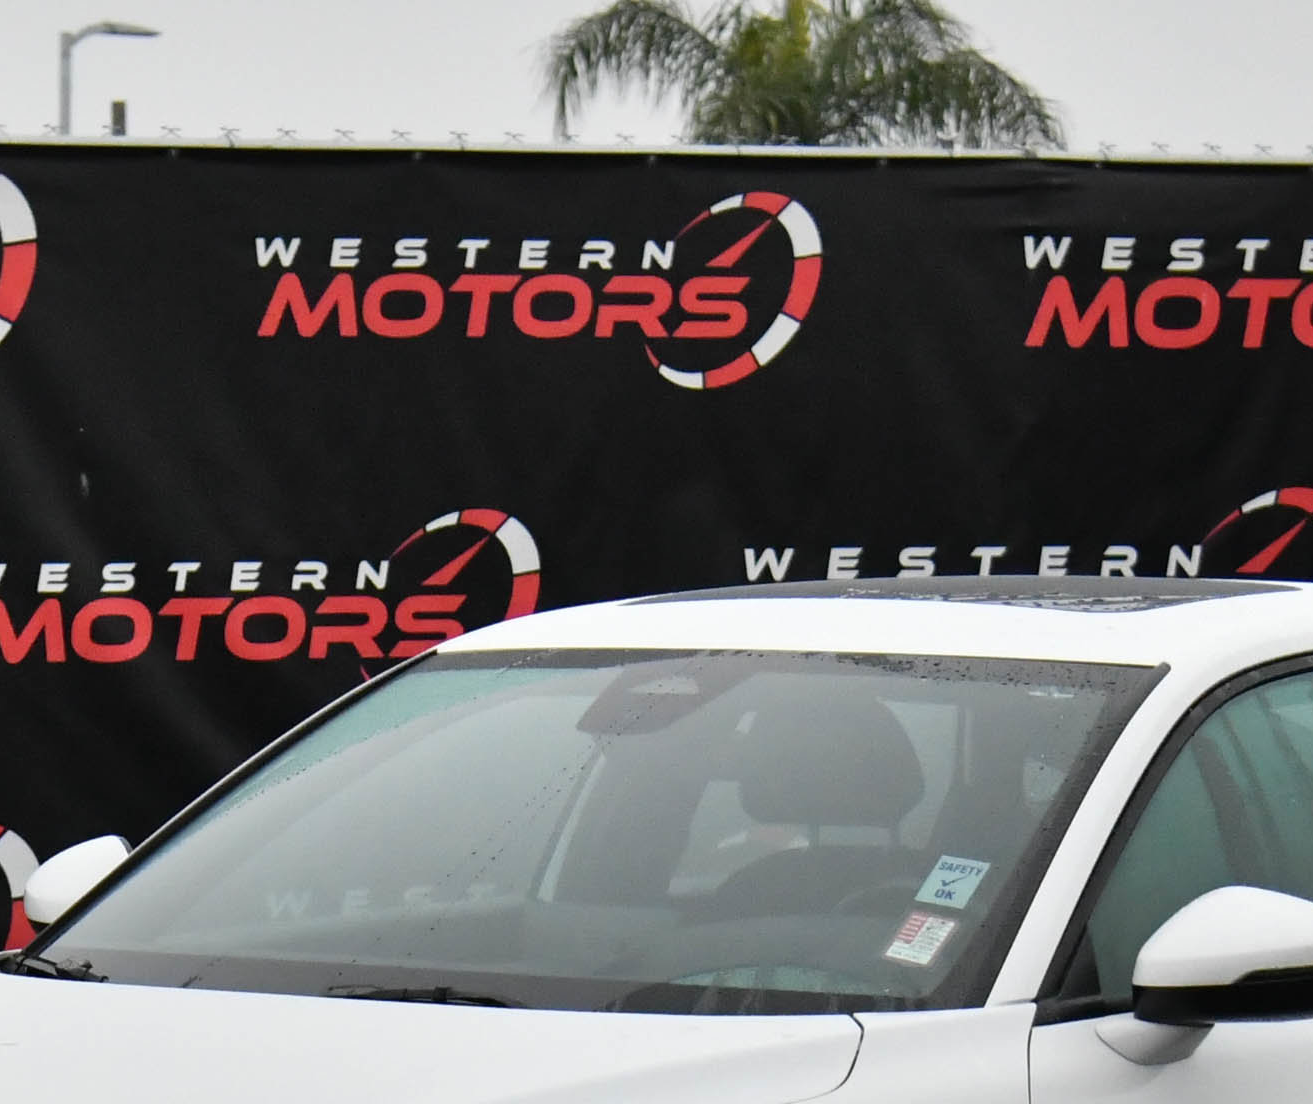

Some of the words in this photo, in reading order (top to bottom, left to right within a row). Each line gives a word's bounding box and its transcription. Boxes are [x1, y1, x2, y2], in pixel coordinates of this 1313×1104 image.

[256, 238, 674, 269] WESTERN
[258, 273, 749, 338] MOTORS
[745, 545, 1201, 578] WESTERN
[938, 861, 983, 876] SAFETY
[934, 888, 956, 901] OK
